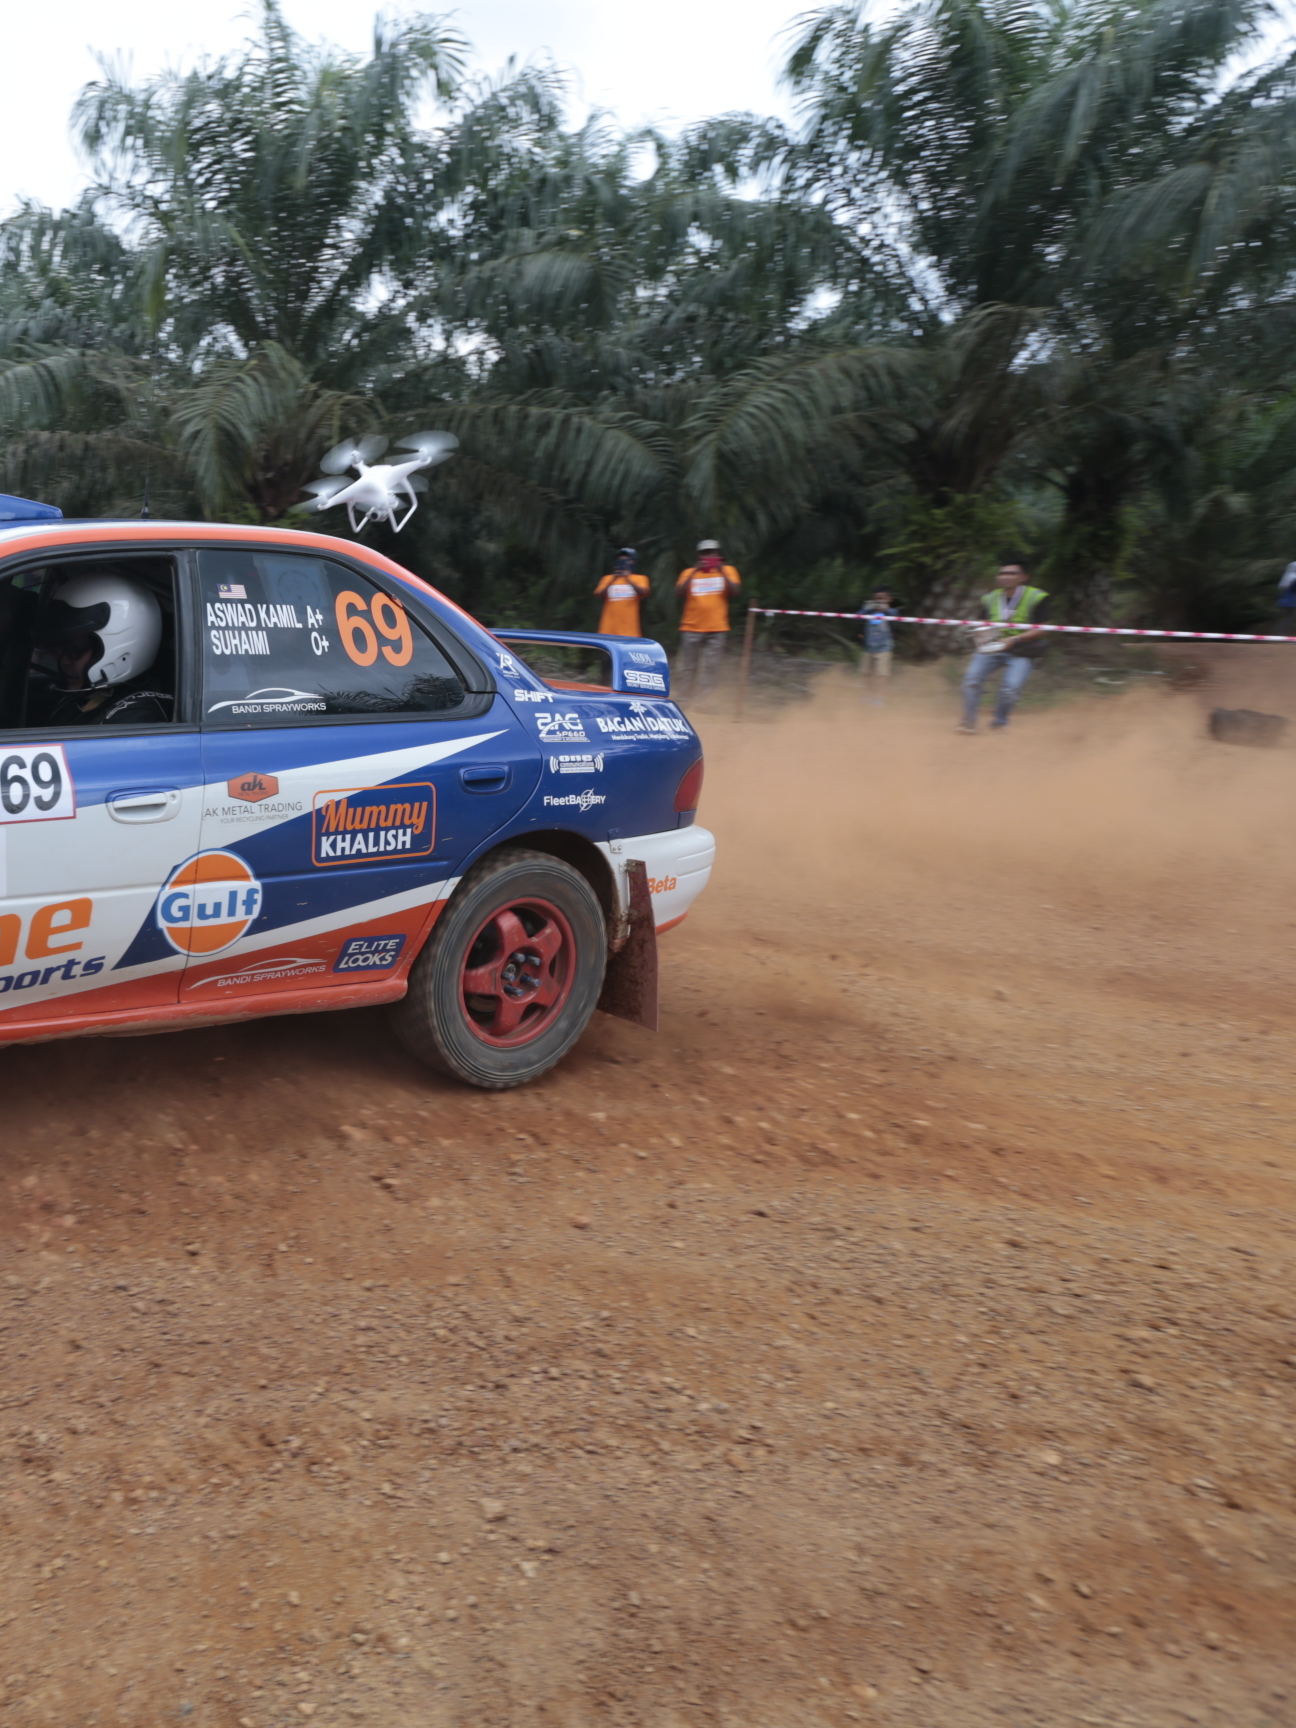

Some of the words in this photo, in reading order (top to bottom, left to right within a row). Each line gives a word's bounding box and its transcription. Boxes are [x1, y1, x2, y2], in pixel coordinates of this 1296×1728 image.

[206, 602, 256, 627] ASWAD
[259, 603, 303, 629] KAMIL
[306, 605, 323, 629] A+
[335, 589, 413, 667] 69
[210, 629, 270, 656] SUHAIMI
[514, 688, 554, 703] SHIFT
[232, 704, 262, 714] BANDI
[263, 702, 327, 713] SPRAYWORKS
[556, 730, 586, 738] SPEED
[595, 716, 644, 733] BAGAN
[646, 716, 689, 733] DATUK
[558, 754, 593, 762] one
[0, 752, 62, 815] 69
[204, 807, 219, 818] AK
[221, 805, 255, 817] METAL
[258, 801, 303, 814] TRADING
[321, 798, 428, 834] Mummy
[320, 827, 412, 857] KHALISH
[160, 887, 259, 924] Gulf
[347, 938, 400, 954] ELITE
[338, 951, 396, 969] LOOKS
[217, 975, 252, 987] BANDI
[253, 964, 327, 983] SPRAYWORKS
